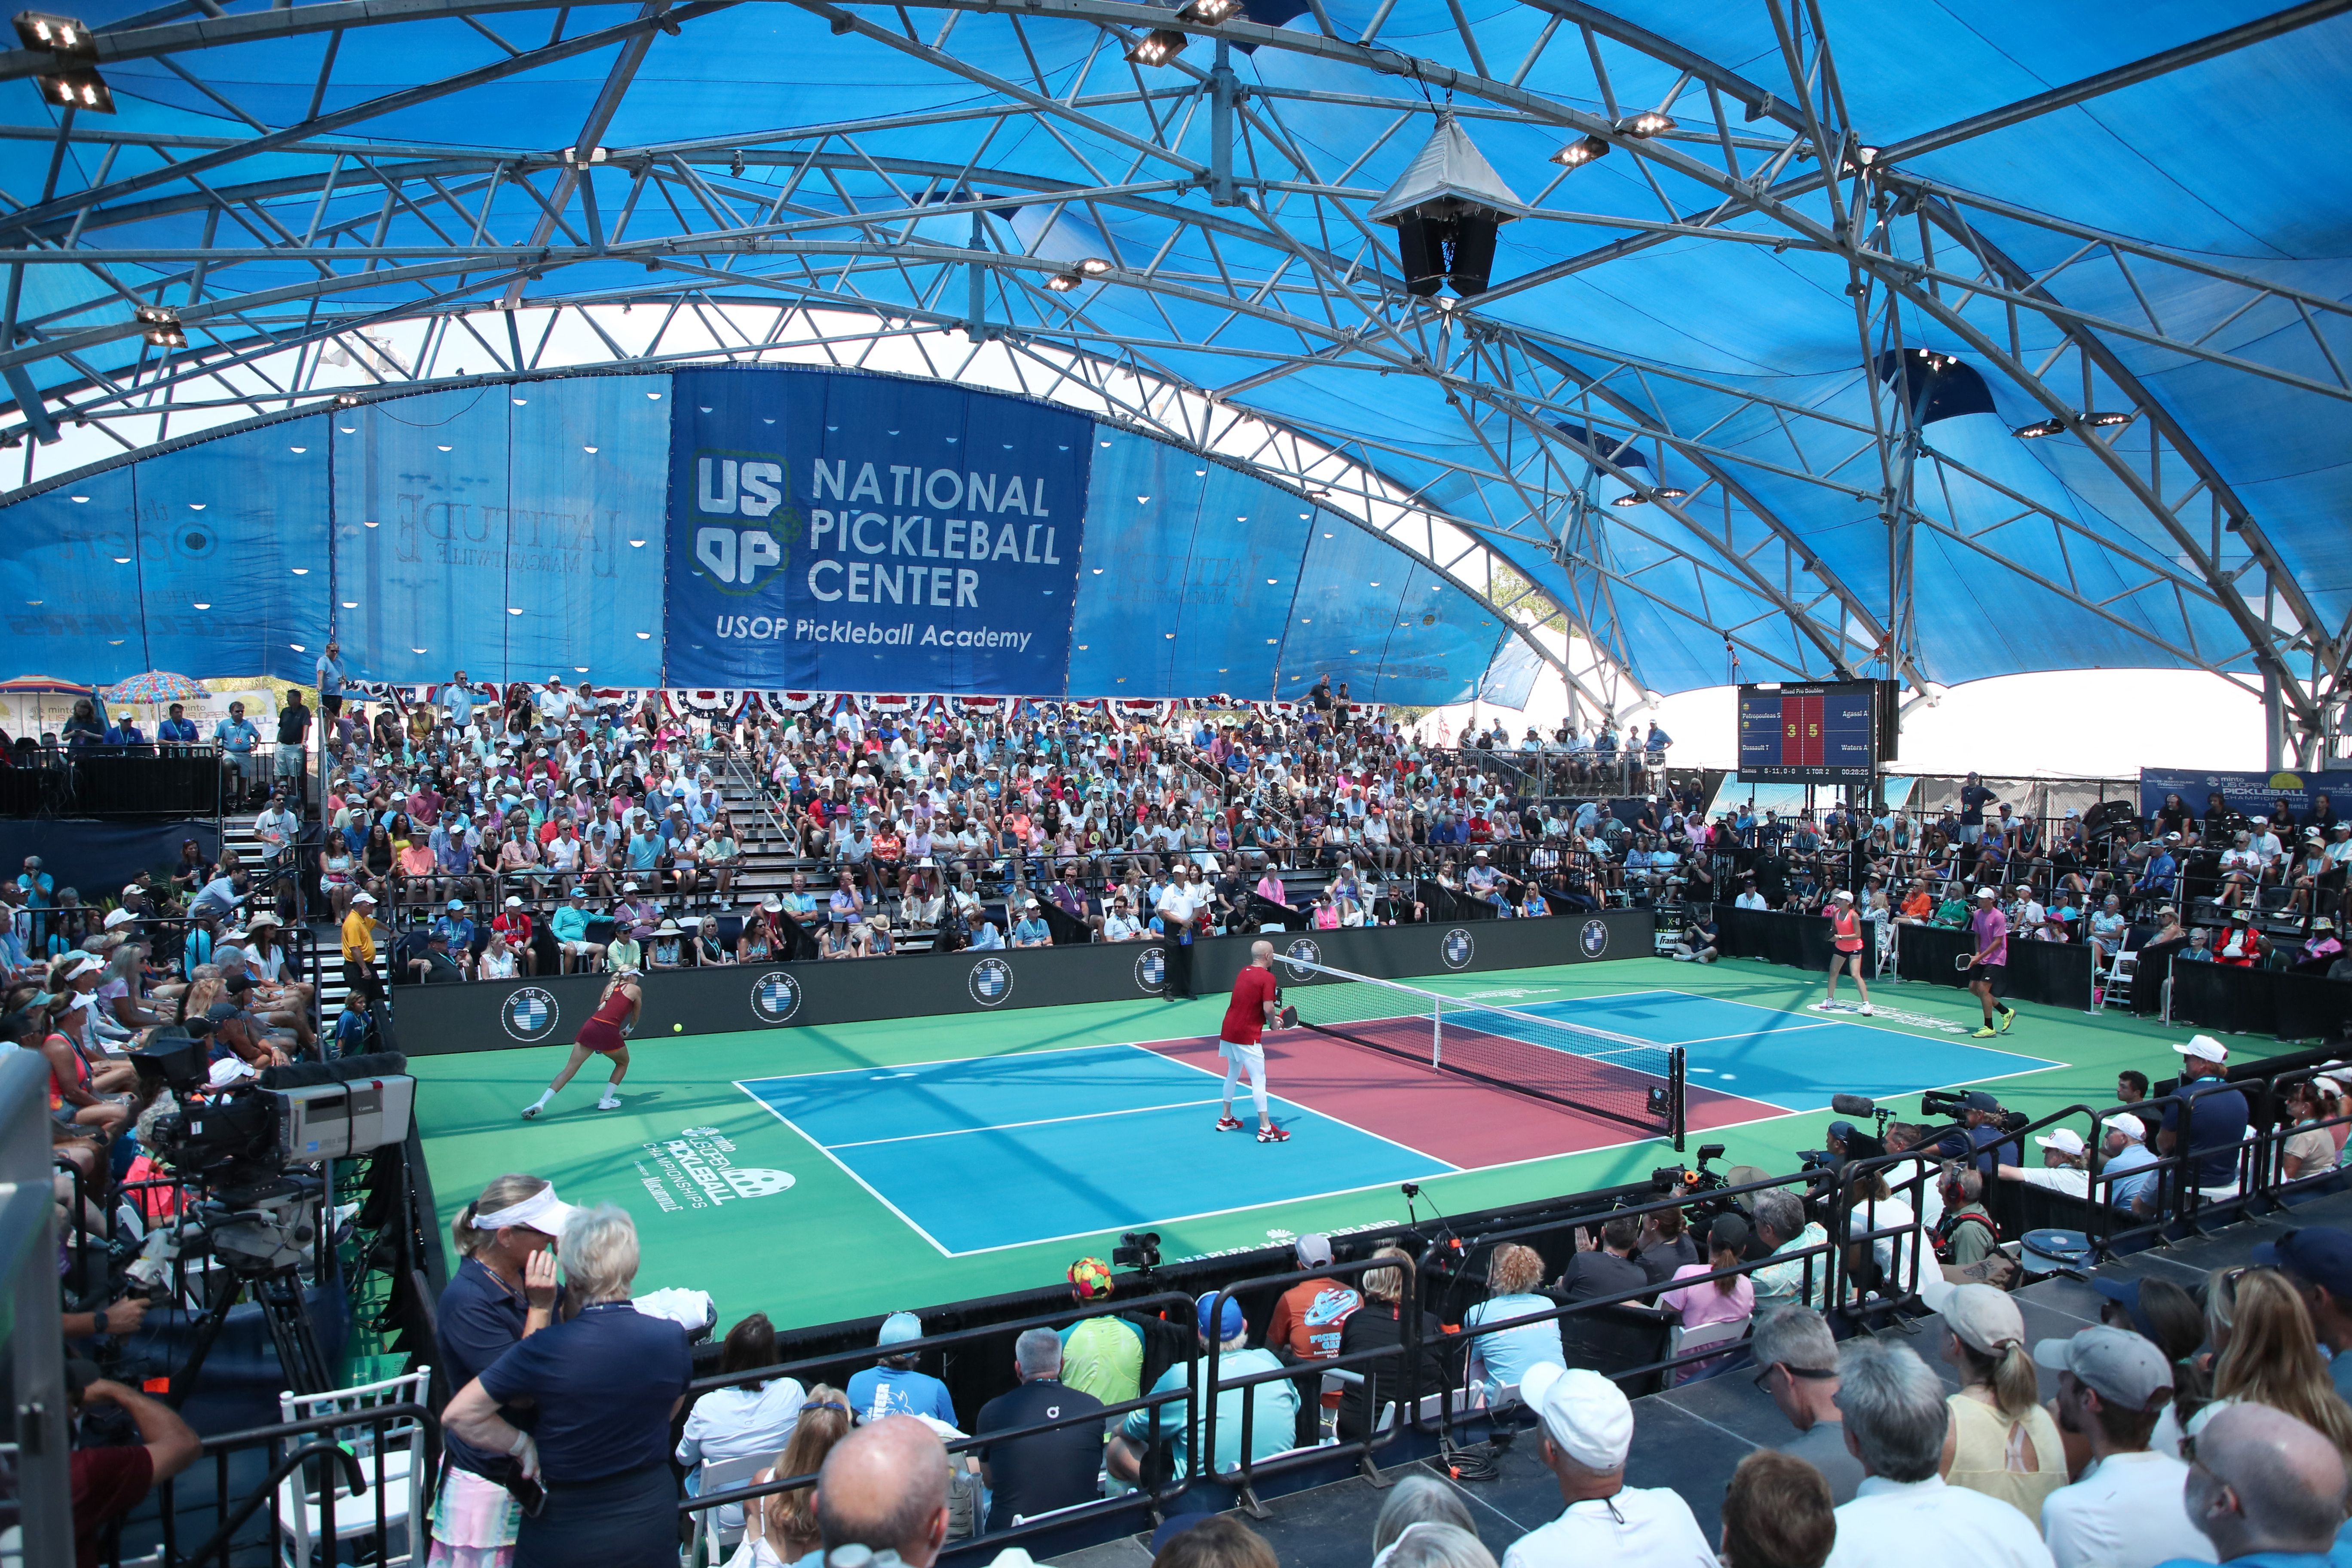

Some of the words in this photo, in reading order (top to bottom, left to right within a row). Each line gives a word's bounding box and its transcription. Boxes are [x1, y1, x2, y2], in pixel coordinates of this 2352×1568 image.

[698, 457, 782, 517] US
[813, 458, 1049, 517] NATIONAL
[811, 510, 1060, 565] PICKLEBALL
[696, 527, 781, 584] OP
[808, 560, 979, 608] CENTER
[717, 615, 788, 640] USOP
[795, 618, 913, 645] Pickleball
[920, 625, 1032, 653] Academy
[1787, 724, 1796, 738] 3
[1809, 724, 1818, 738] 5
[2223, 788, 2308, 796] PICKLEBALL
[1447, 931, 1469, 942] BMW
[1660, 936, 1683, 945] Franklin
[1290, 942, 1317, 953] BMW
[975, 961, 1007, 974] BMW
[759, 974, 794, 989] BMW
[509, 990, 551, 1006] BMW
[689, 1137, 711, 1149] US
[709, 1135, 736, 1152] minto
[698, 1148, 735, 1171] OPEN
[643, 1142, 707, 1209] CHAMPIONSHIPS
[662, 1139, 735, 1205] PICKLEBALL
[641, 1176, 683, 1213] MARGARITAVILLE
[1262, 1232, 1331, 1249] MAO
[1331, 1219, 1400, 1237] ISLAND
